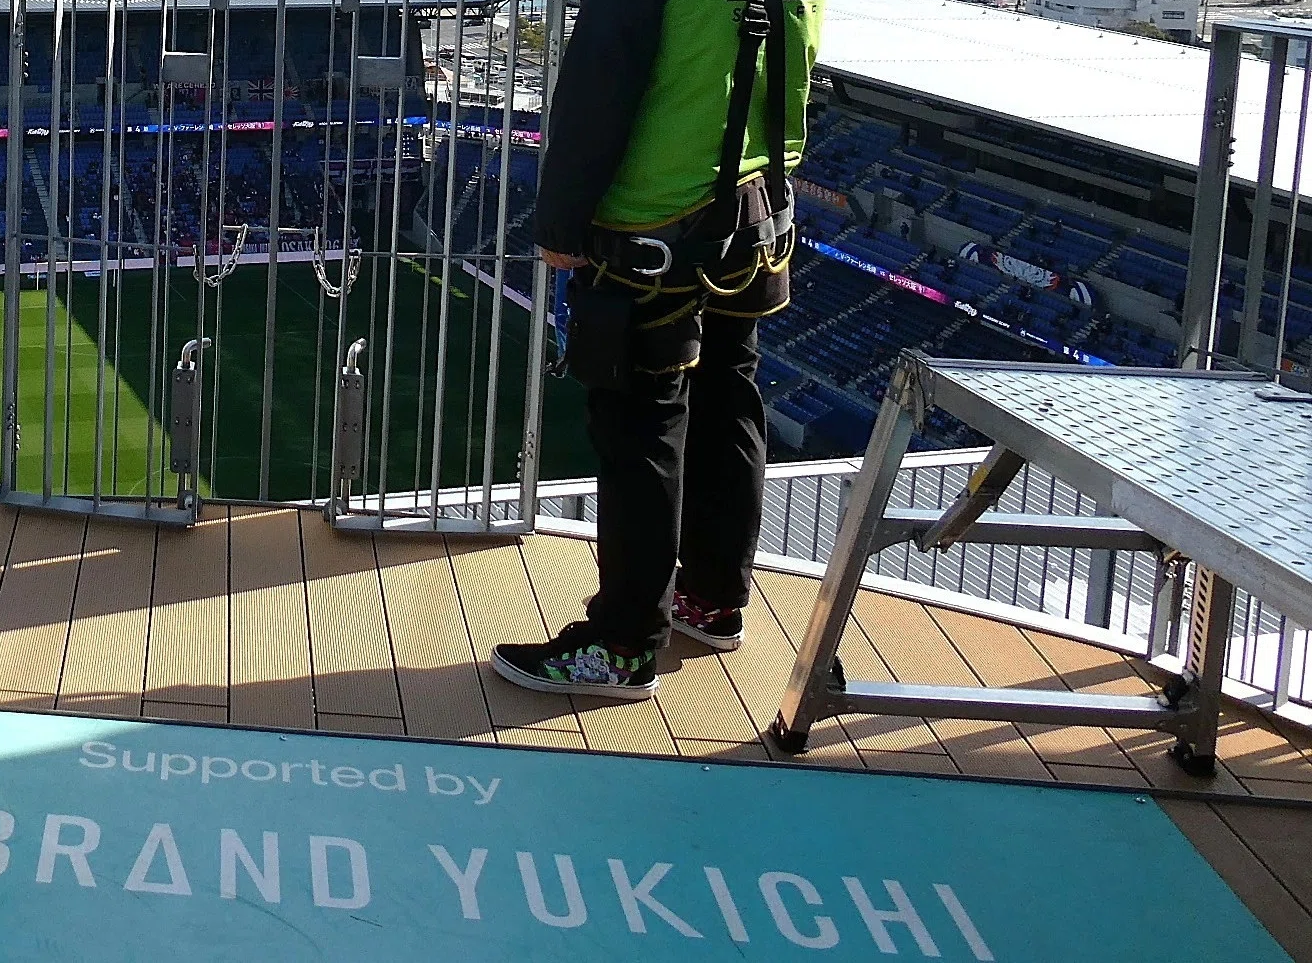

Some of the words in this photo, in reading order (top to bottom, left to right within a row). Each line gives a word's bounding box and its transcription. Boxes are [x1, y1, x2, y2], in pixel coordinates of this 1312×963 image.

[78, 740, 407, 793] Supported
[425, 766, 502, 805] by
[427, 843, 995, 962] YUKICHI
